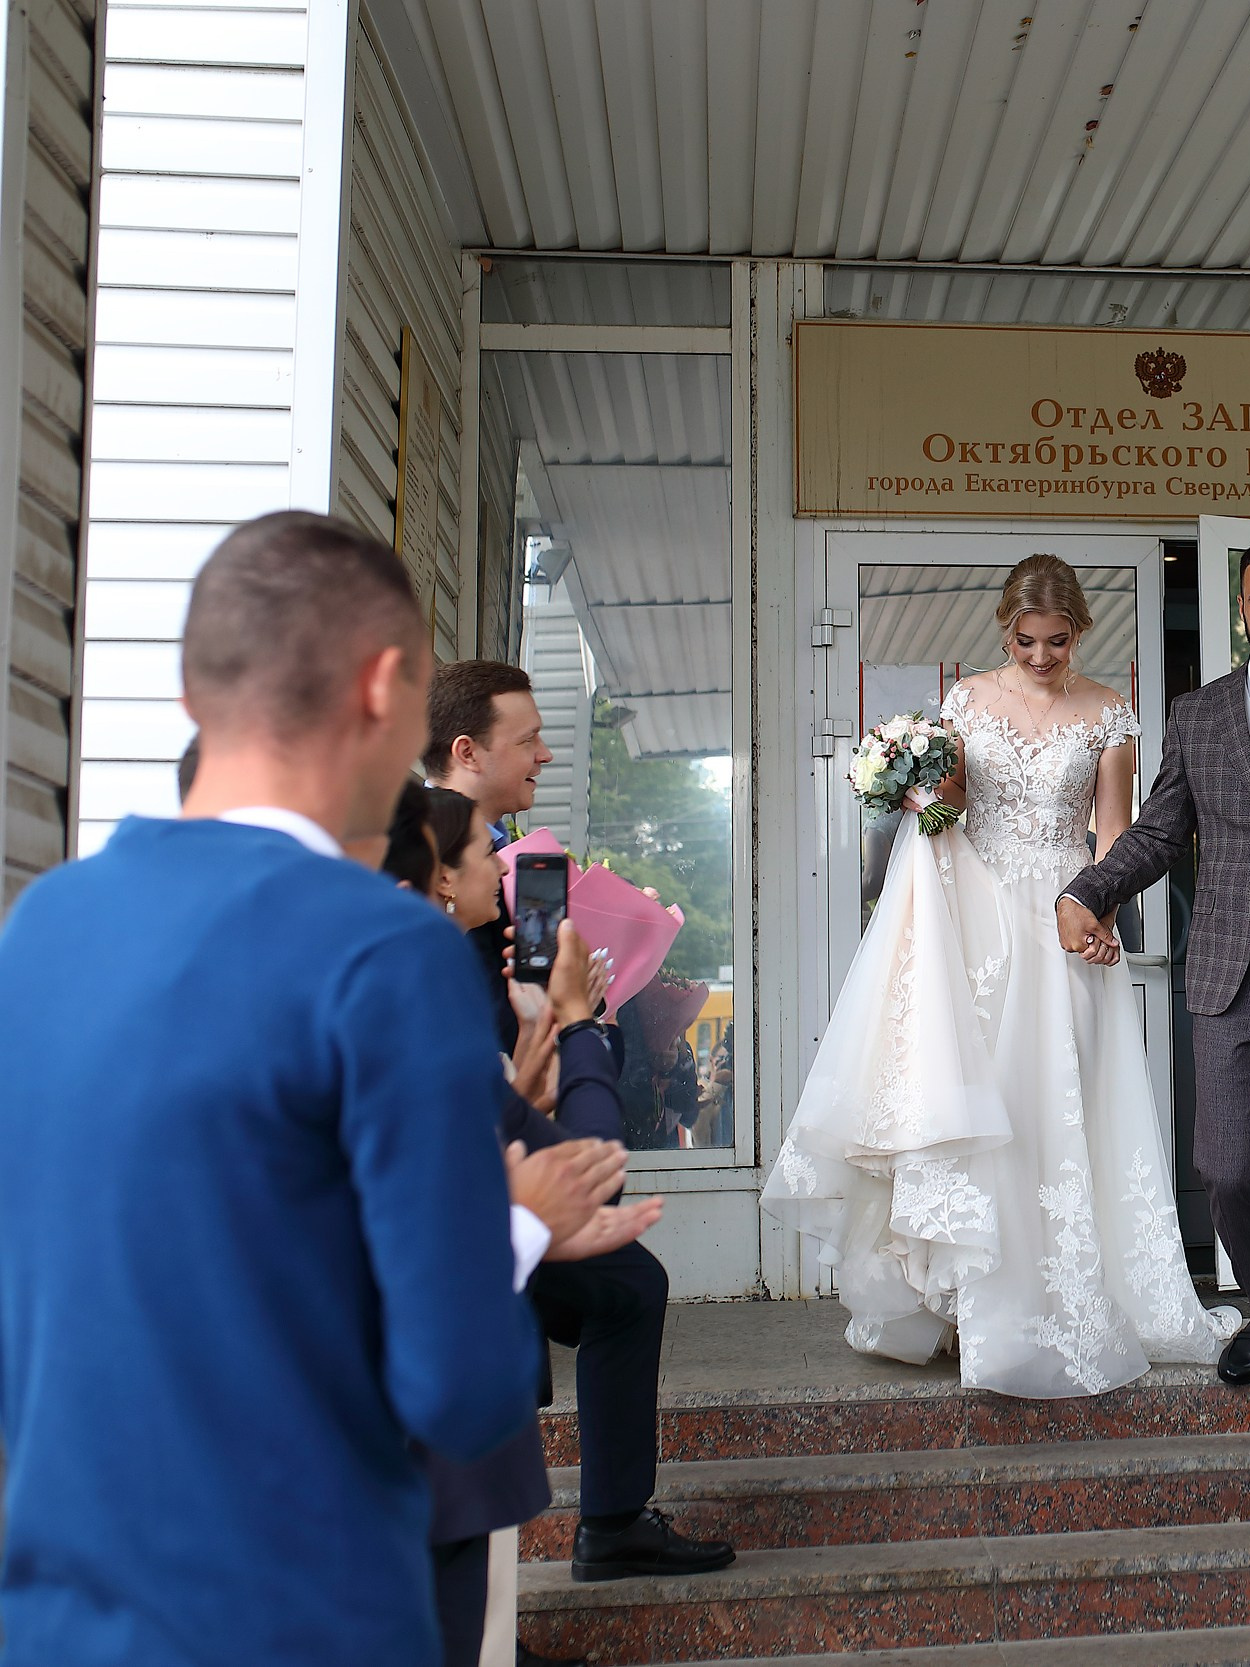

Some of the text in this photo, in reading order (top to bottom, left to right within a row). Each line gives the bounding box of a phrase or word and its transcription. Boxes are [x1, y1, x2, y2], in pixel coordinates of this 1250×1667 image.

[1030, 398, 1164, 435] Отдел
[922, 433, 1228, 473] Октябрьского
[867, 476, 955, 496] города
[965, 473, 1157, 499] Екатеринбурга
